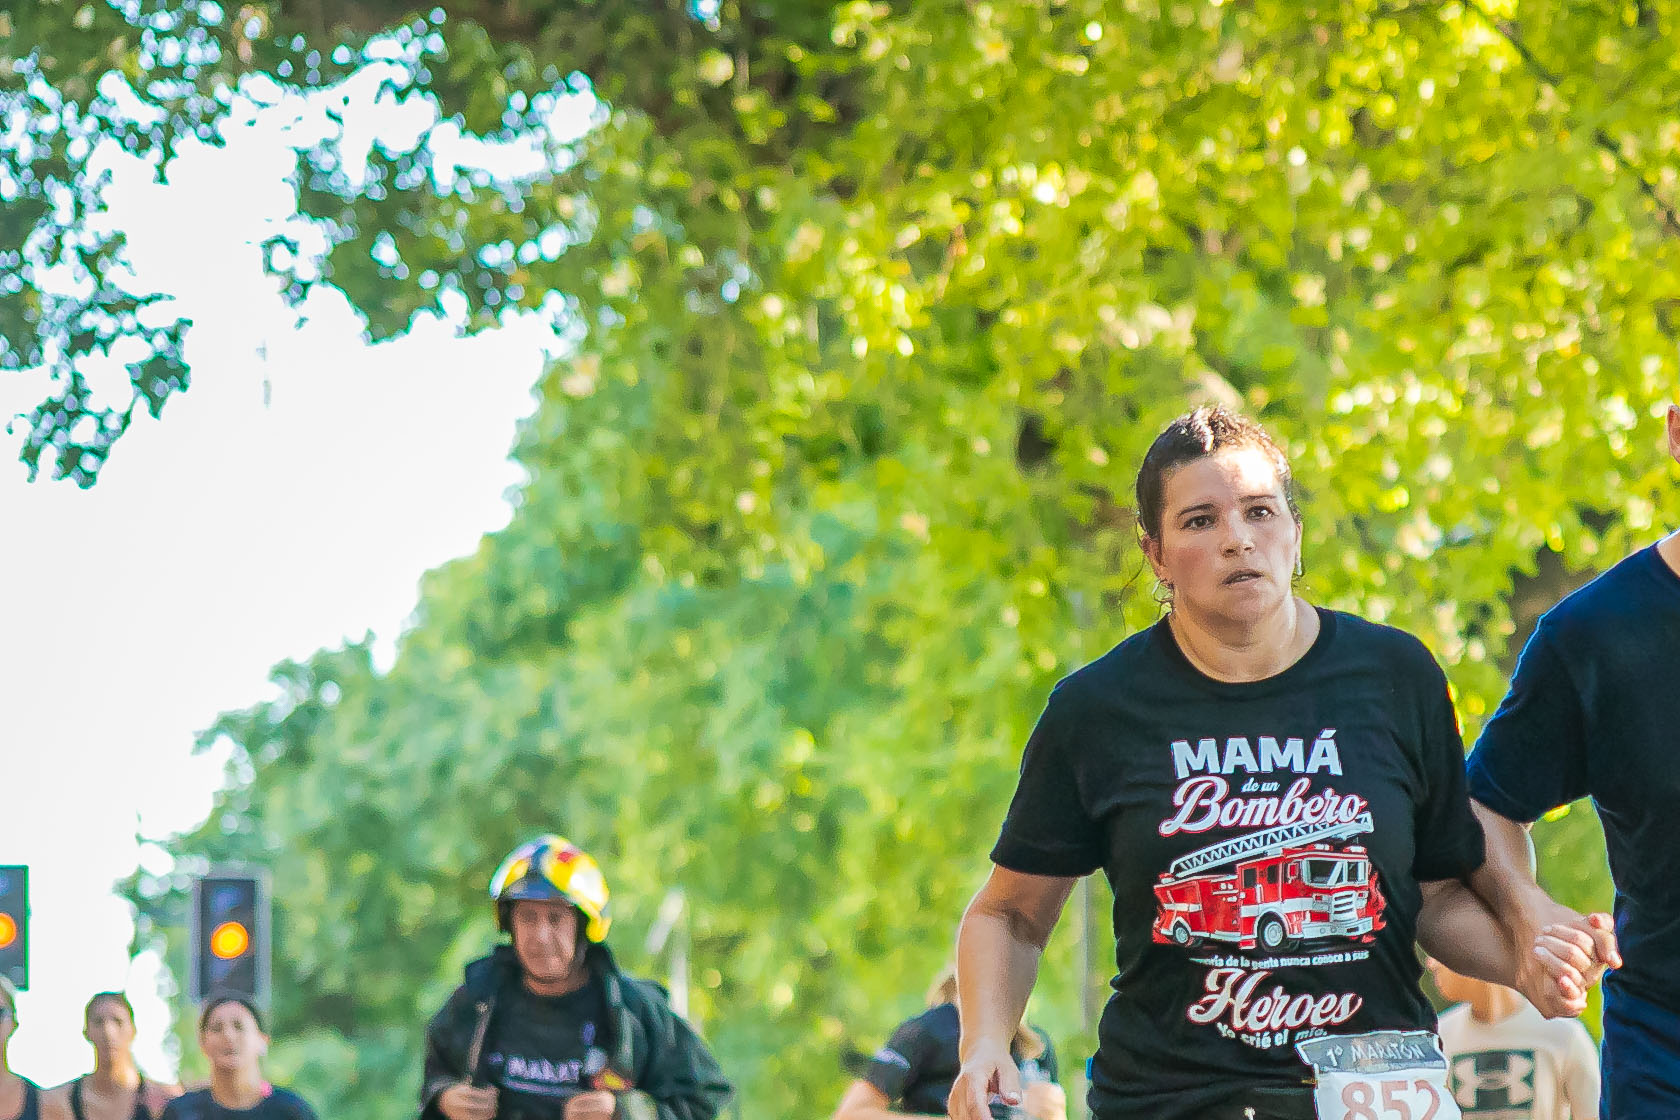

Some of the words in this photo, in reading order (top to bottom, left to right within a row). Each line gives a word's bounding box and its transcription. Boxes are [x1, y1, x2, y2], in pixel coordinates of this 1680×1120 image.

[1171, 728, 1343, 779] MAMÁ
[1241, 777, 1260, 792] de
[1260, 782, 1280, 792] un
[1158, 775, 1368, 837] Bombero
[1225, 954, 1239, 967] de
[1240, 955, 1251, 967] la
[1251, 957, 1279, 970] gente
[1280, 957, 1311, 967] nunca
[1312, 953, 1344, 966] conoce
[1187, 967, 1362, 1032] Heroes
[1274, 1029, 1290, 1046] el
